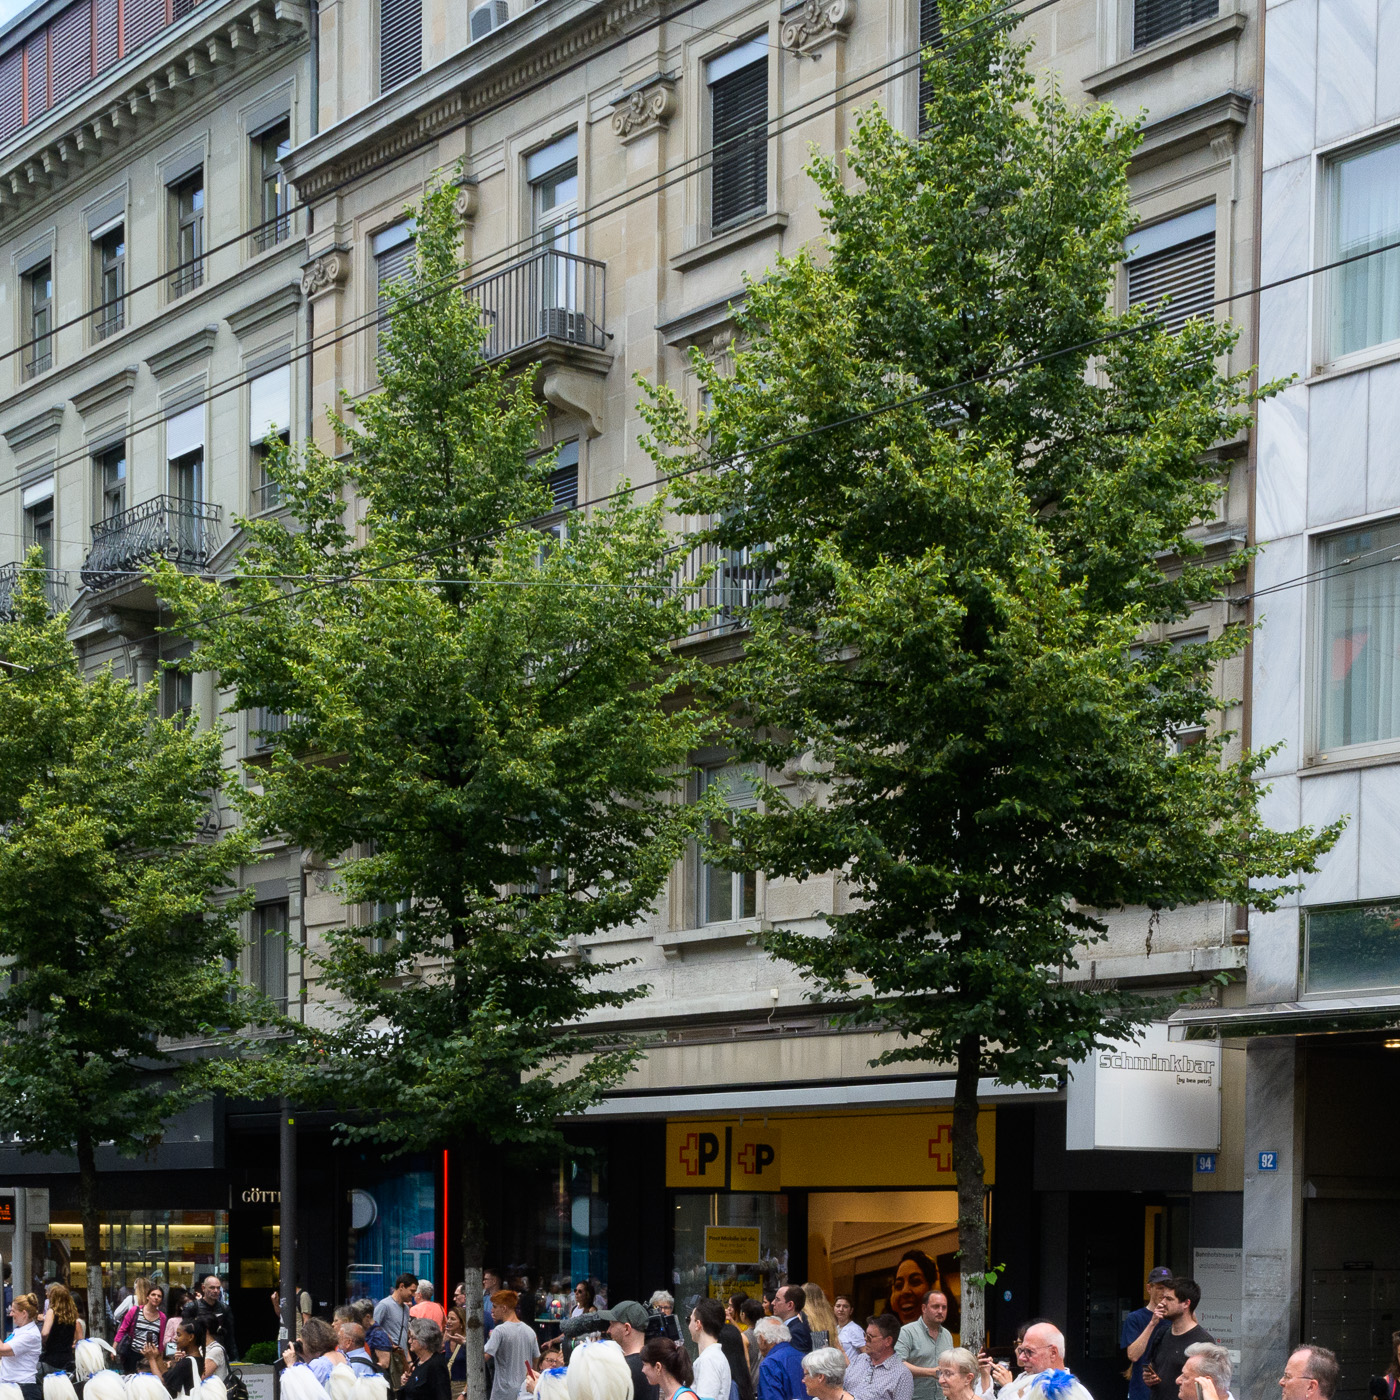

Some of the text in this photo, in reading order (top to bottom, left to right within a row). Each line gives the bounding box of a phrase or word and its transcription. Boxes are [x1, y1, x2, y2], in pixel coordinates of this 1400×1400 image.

[1099, 1051, 1216, 1074] schminkbar
[1200, 1157, 1211, 1170] 94
[1261, 1155, 1273, 1168] 92
